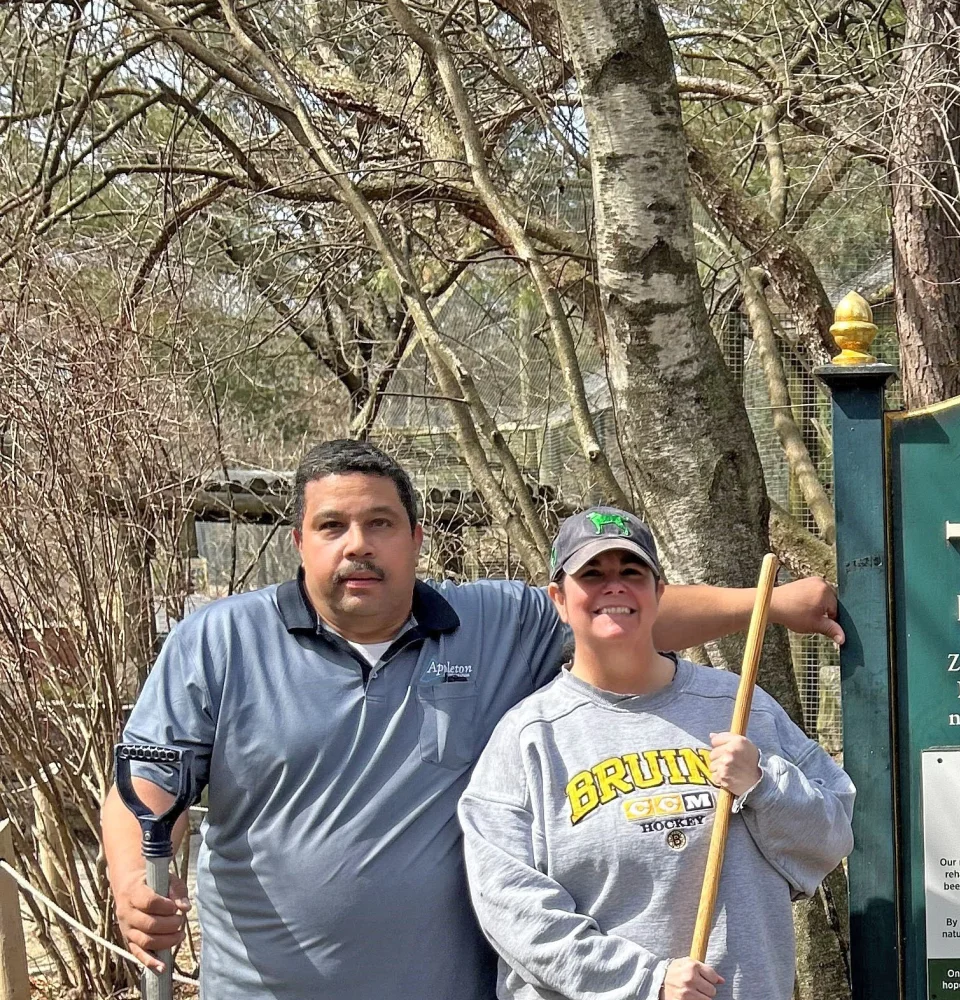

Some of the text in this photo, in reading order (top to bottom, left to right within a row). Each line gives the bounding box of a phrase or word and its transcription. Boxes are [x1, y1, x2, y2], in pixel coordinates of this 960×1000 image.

[565, 748, 722, 826] BRUIN
[626, 792, 713, 818] CCM
[640, 815, 706, 833] HOCKEY
[939, 857, 956, 866] Our
[946, 917, 958, 927] By
[947, 969, 960, 977] On
